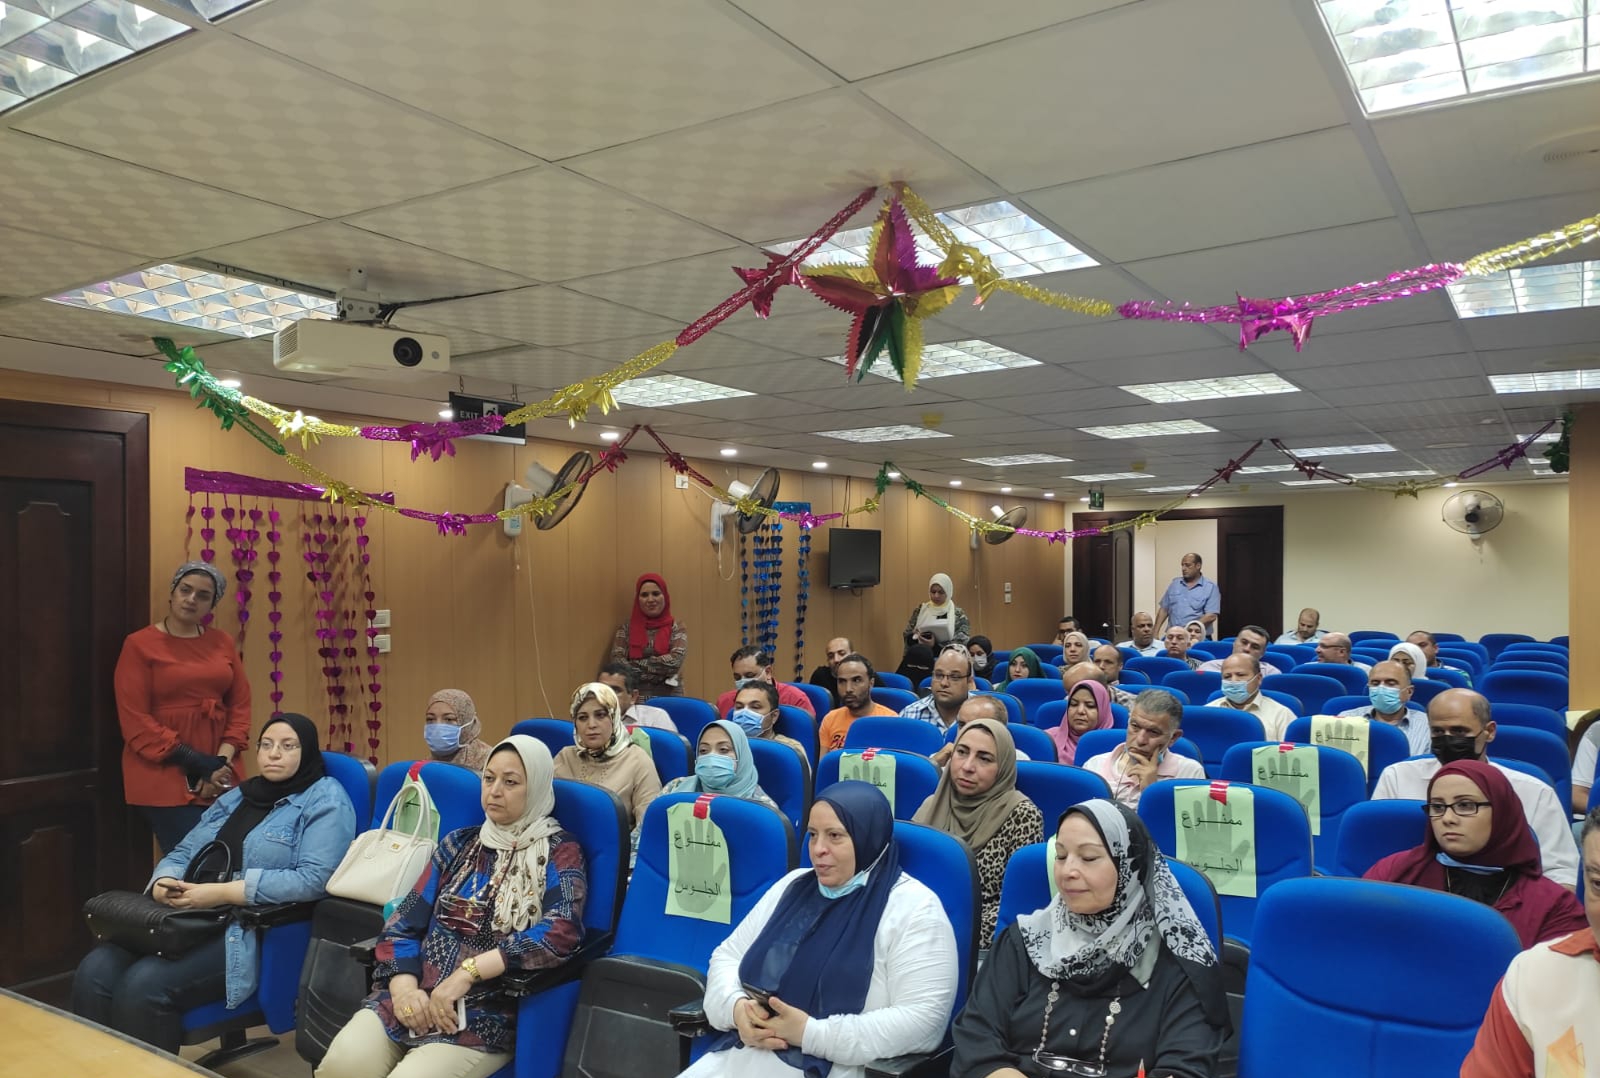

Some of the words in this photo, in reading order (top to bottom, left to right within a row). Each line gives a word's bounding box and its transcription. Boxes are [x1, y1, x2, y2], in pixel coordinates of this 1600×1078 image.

[460, 410, 480, 420] EXIT
[1315, 730, 1360, 743] ممنوع
[1257, 766, 1309, 780] ممنوع
[1181, 812, 1243, 829] ممنوع
[673, 832, 721, 849] ممنوع
[674, 880, 721, 898] الجلوس
